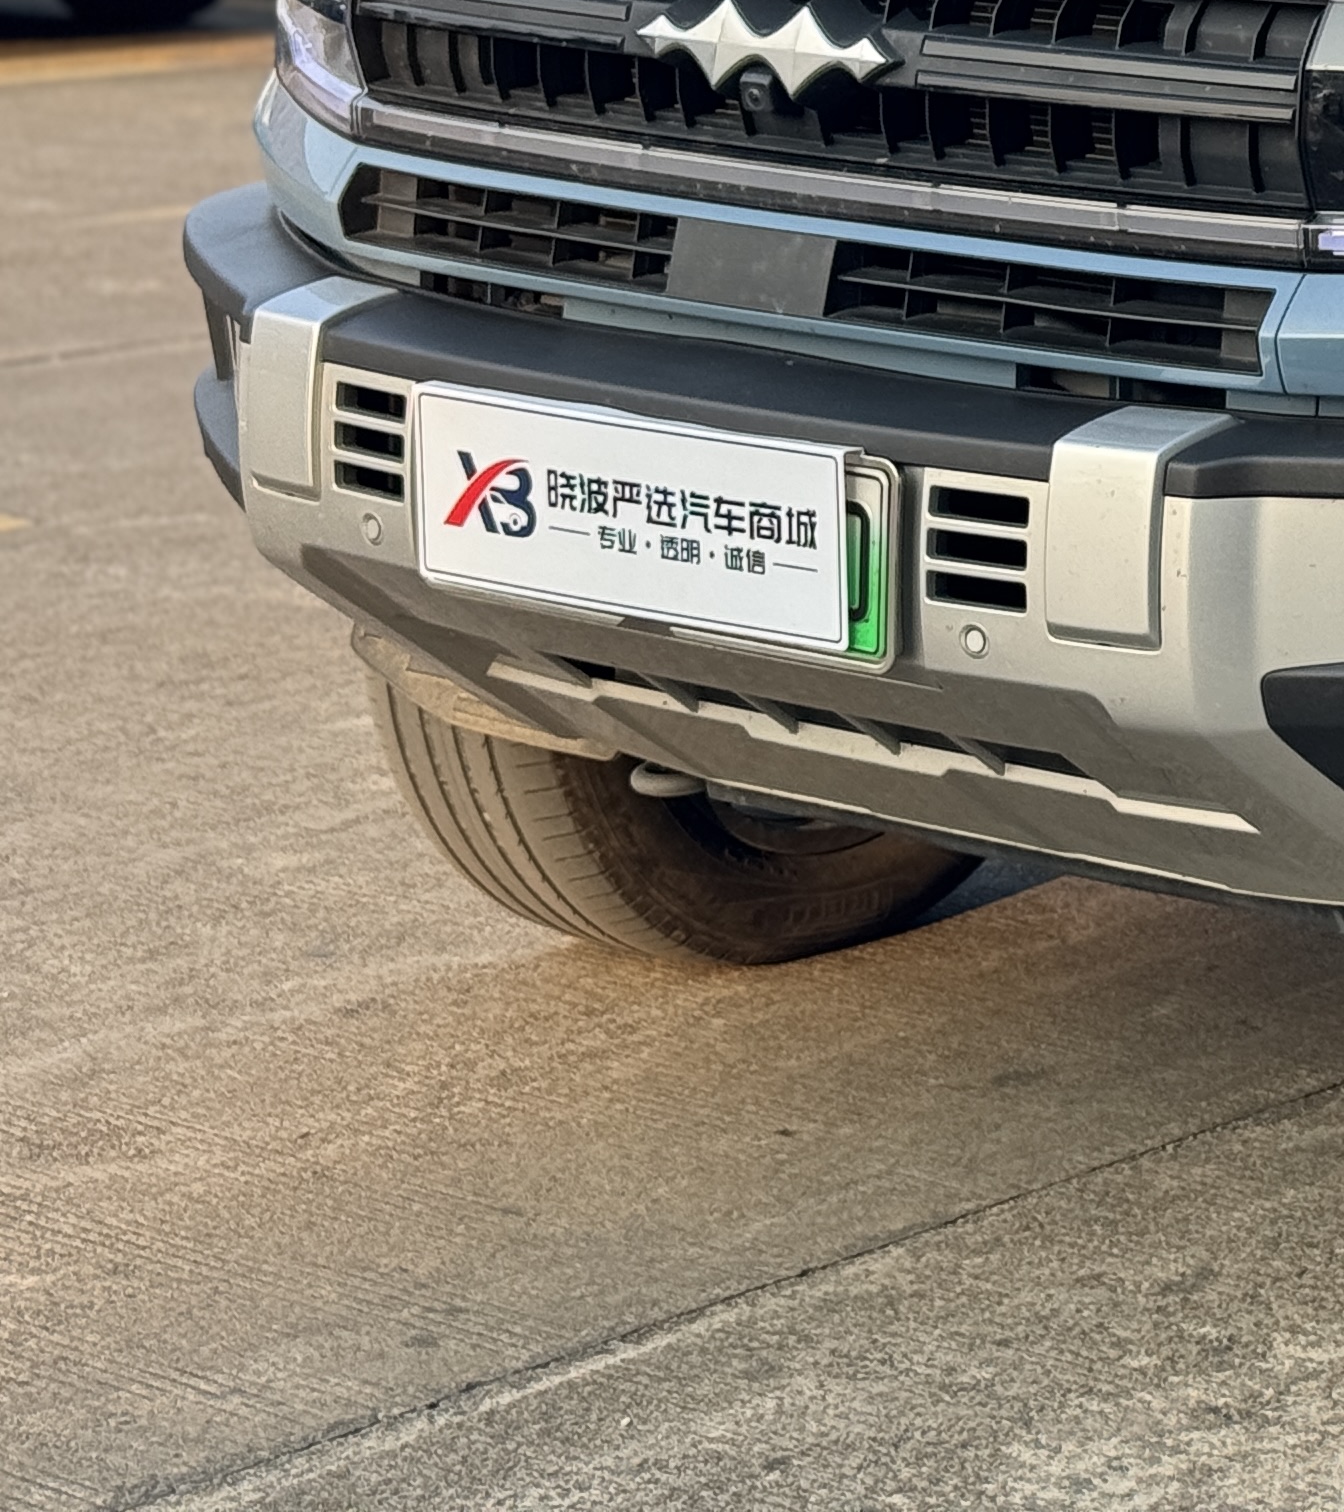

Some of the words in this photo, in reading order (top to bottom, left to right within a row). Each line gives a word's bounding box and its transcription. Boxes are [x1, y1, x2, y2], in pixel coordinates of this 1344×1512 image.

[546, 468, 818, 549] 晓波严选汽车商城
